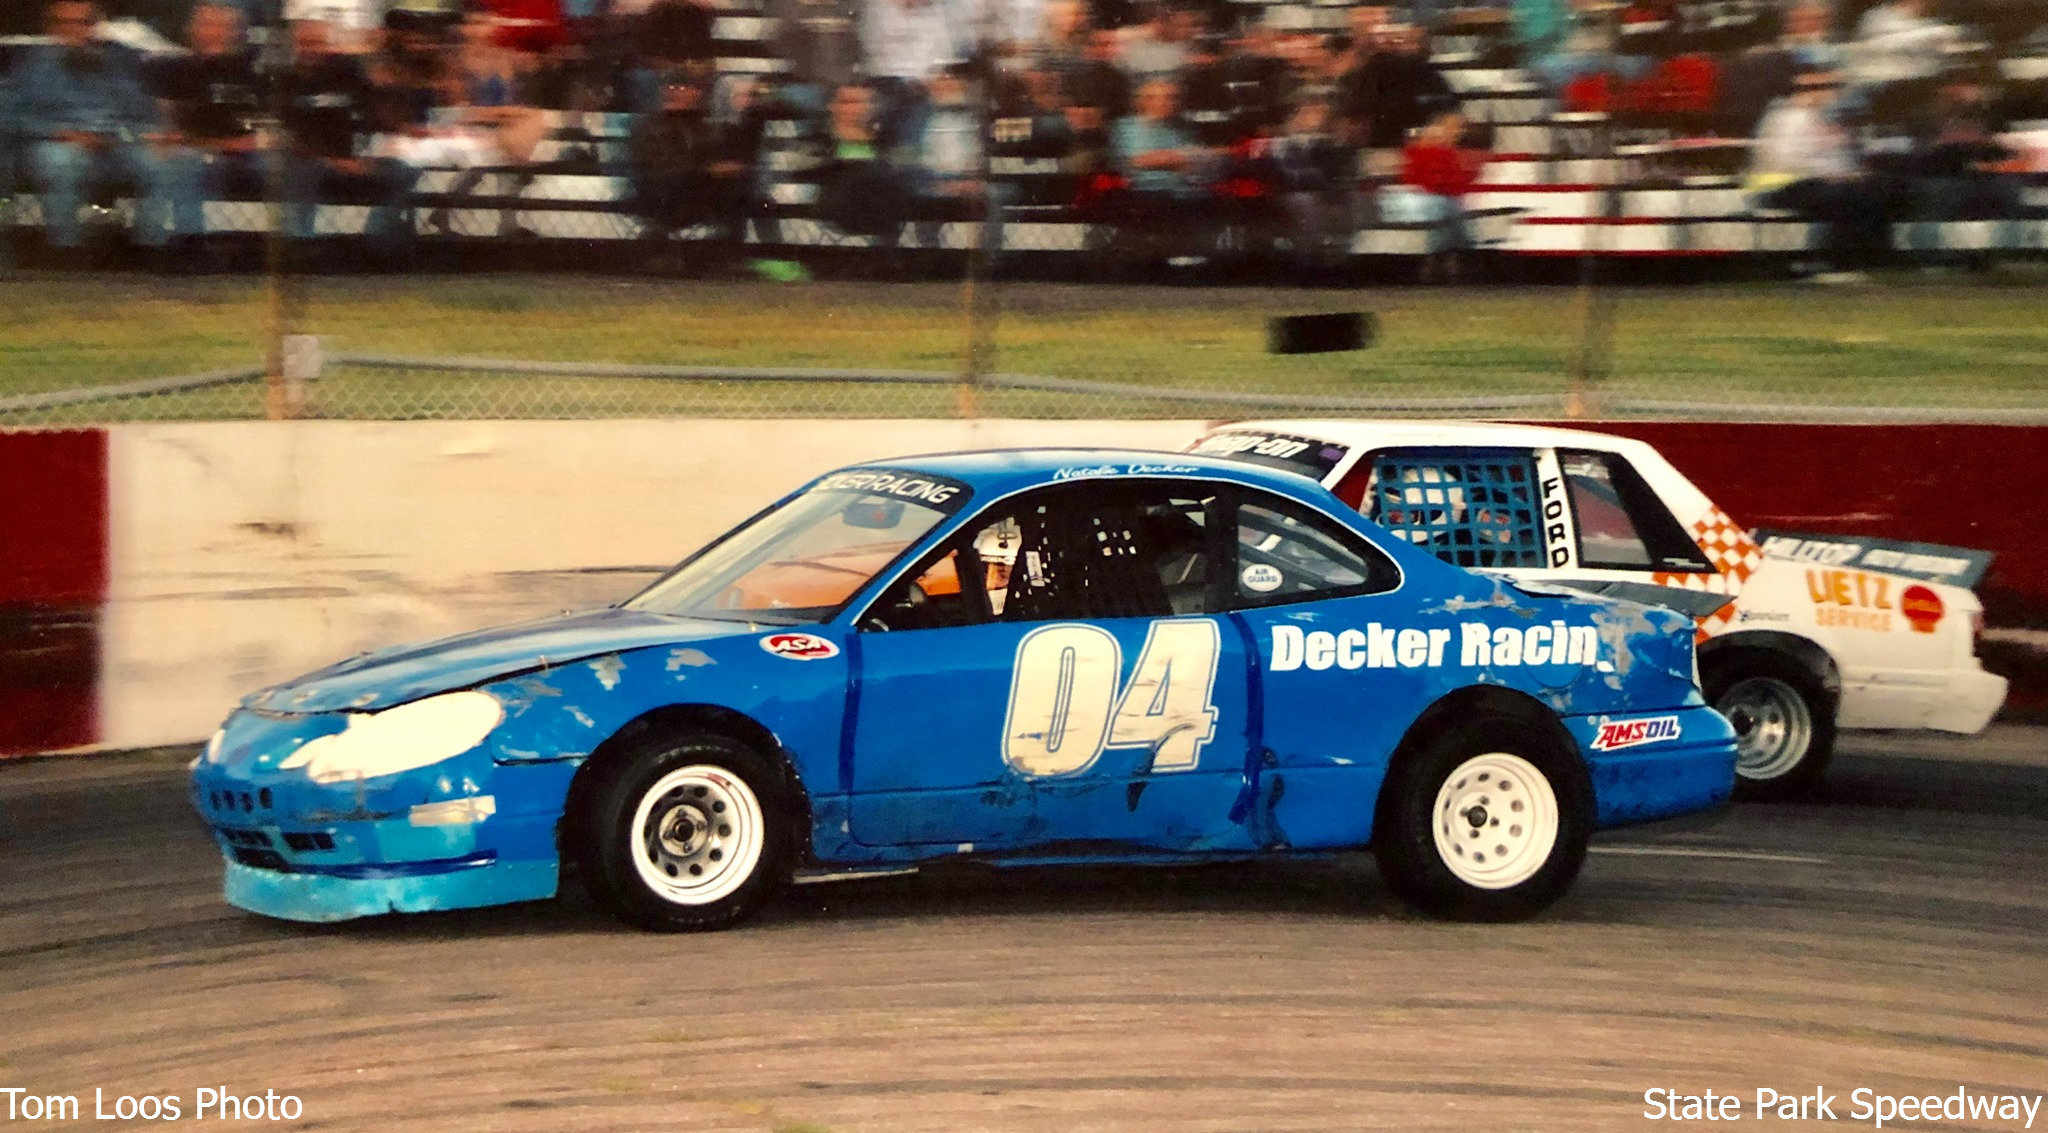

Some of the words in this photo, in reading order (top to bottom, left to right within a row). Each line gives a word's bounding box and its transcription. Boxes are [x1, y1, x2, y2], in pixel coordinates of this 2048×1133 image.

[1128, 463, 1200, 474] Decker
[1542, 477, 1570, 568] FORD
[776, 639, 822, 653] ASA
[1270, 622, 1451, 671] Decker
[1460, 620, 1614, 672] Racin
[1002, 617, 1221, 777] 04
[1597, 719, 1677, 748] AMSOIL
